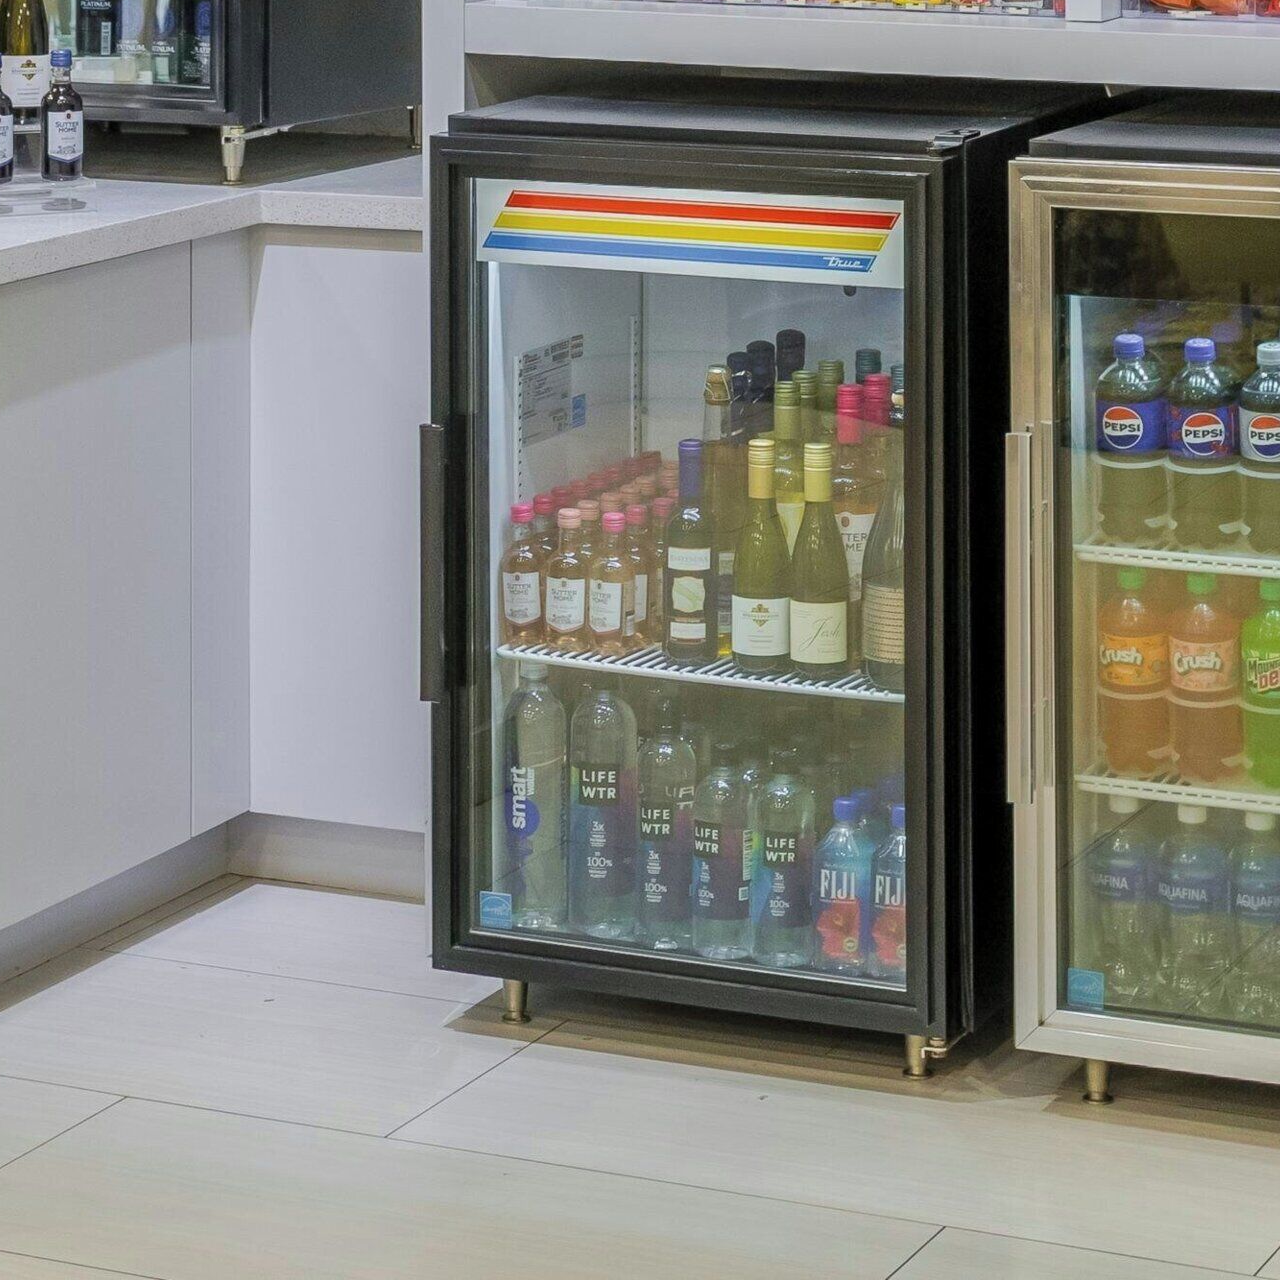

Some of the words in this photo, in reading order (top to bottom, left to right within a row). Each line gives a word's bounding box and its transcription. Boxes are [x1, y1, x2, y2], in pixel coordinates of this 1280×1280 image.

[823, 256, 864, 269] True
[1104, 421, 1141, 433] PEPSI
[1185, 428, 1222, 439] PEPSI
[1100, 645, 1143, 666] Crush
[1174, 652, 1222, 671] Crush
[582, 770, 616, 783] LIFE
[511, 766, 526, 829] smart
[582, 786, 616, 800] WTR
[641, 807, 670, 820] LIFE
[641, 822, 670, 835] WTR
[695, 826, 719, 840] LIFE
[695, 840, 719, 854] WTR
[766, 837, 796, 849] LIFE
[587, 857, 612, 867] 100%
[766, 850, 795, 863] WTR
[645, 882, 667, 893] 100%
[820, 869, 856, 900] FIJI
[875, 874, 906, 905] FIJ
